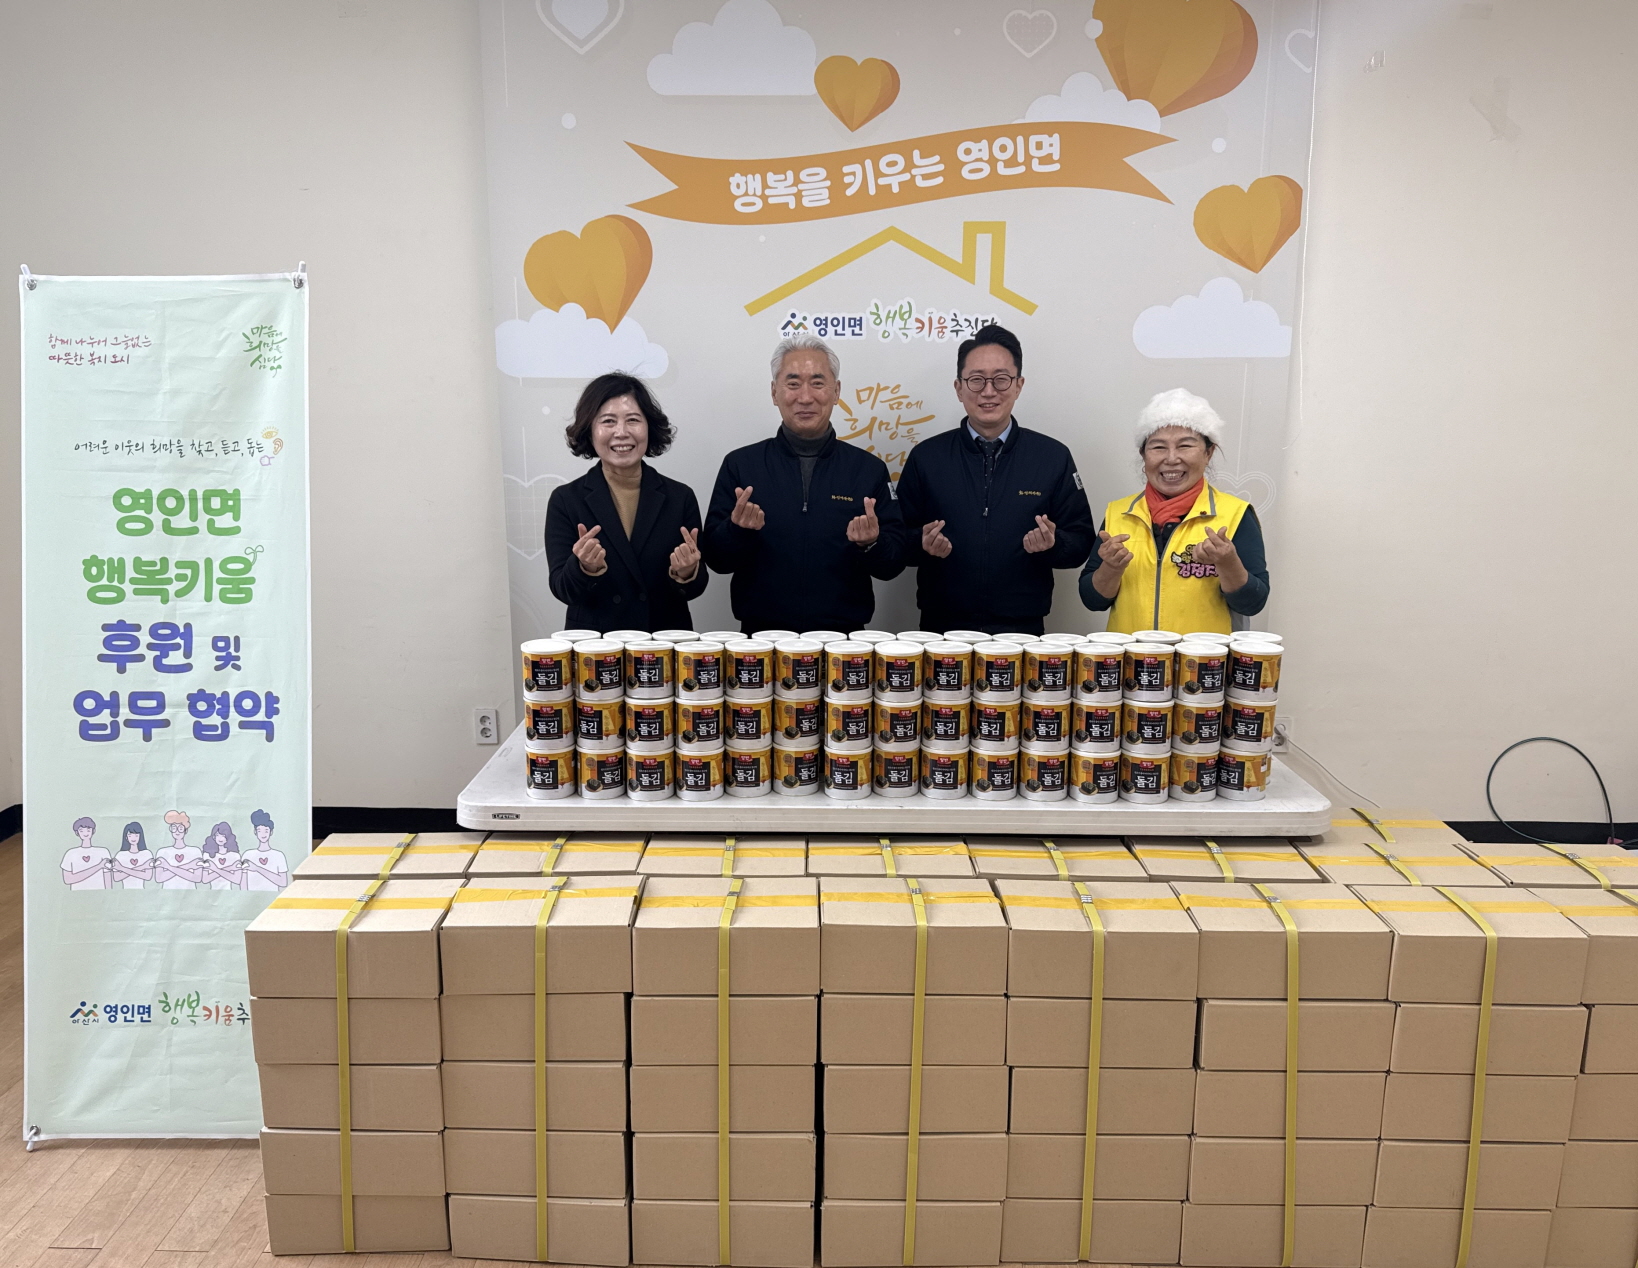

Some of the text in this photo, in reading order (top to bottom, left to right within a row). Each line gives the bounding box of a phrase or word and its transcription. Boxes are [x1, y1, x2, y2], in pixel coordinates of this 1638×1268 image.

[729, 133, 1061, 213] 행복을 키우는 영인면
[250, 324, 283, 338] 마음에
[813, 316, 863, 337] 영인면
[48, 333, 72, 349] 함께
[48, 351, 130, 366] 따뜻한 복지 도시
[856, 382, 923, 411] 마음에
[837, 398, 936, 445] 희망을
[74, 438, 265, 458] 어려운 이웃의 희망을 찾고, 듣고, 돕는
[112, 487, 242, 537] 영인면
[82, 554, 256, 605] 행복키움
[97, 619, 242, 674] 후원 및
[536, 672, 557, 686] 돌김
[600, 672, 619, 684] 돌김
[638, 669, 659, 682] 돌김
[698, 670, 718, 683] 돌김
[739, 670, 760, 683] 돌김
[797, 670, 816, 682] 돌김
[847, 671, 866, 684] 돌김
[890, 673, 910, 686] 돌김
[937, 672, 958, 684] 돌김
[990, 672, 1010, 685] 돌김
[1043, 672, 1063, 685] 돌김
[1099, 673, 1118, 685] 돌김
[1138, 672, 1159, 684] 돌김
[1202, 674, 1222, 686] 돌김
[1234, 671, 1255, 684] 돌김
[73, 688, 280, 743] 업무 협약
[537, 721, 558, 734] 돌김
[580, 721, 597, 734] 돌김
[638, 722, 659, 735] 돌김
[697, 722, 717, 735] 돌김
[735, 720, 756, 733] 돌김
[800, 718, 817, 731] 돌김
[847, 721, 866, 734] 돌김
[894, 723, 914, 737] 돌김
[935, 722, 956, 735] 돌김
[980, 722, 1000, 735] 돌김
[1036, 722, 1057, 735] 돌김
[1090, 723, 1111, 736] 돌김
[1200, 723, 1218, 737] 돌김
[1236, 722, 1257, 735] 돌김
[1142, 725, 1163, 738] 돌김
[533, 771, 553, 784] 돌김
[602, 769, 621, 782] 돌김
[640, 773, 660, 786] 돌김
[686, 772, 705, 785] 돌김
[735, 767, 755, 780] 돌김
[833, 772, 853, 784] 돌김
[888, 769, 909, 782] 돌김
[933, 771, 954, 784] 돌김
[992, 773, 1011, 784] 돌김
[1042, 772, 1062, 785] 돌김
[1098, 774, 1115, 787] 돌김
[1135, 776, 1156, 788] 돌김
[103, 1004, 151, 1023] 영인면
